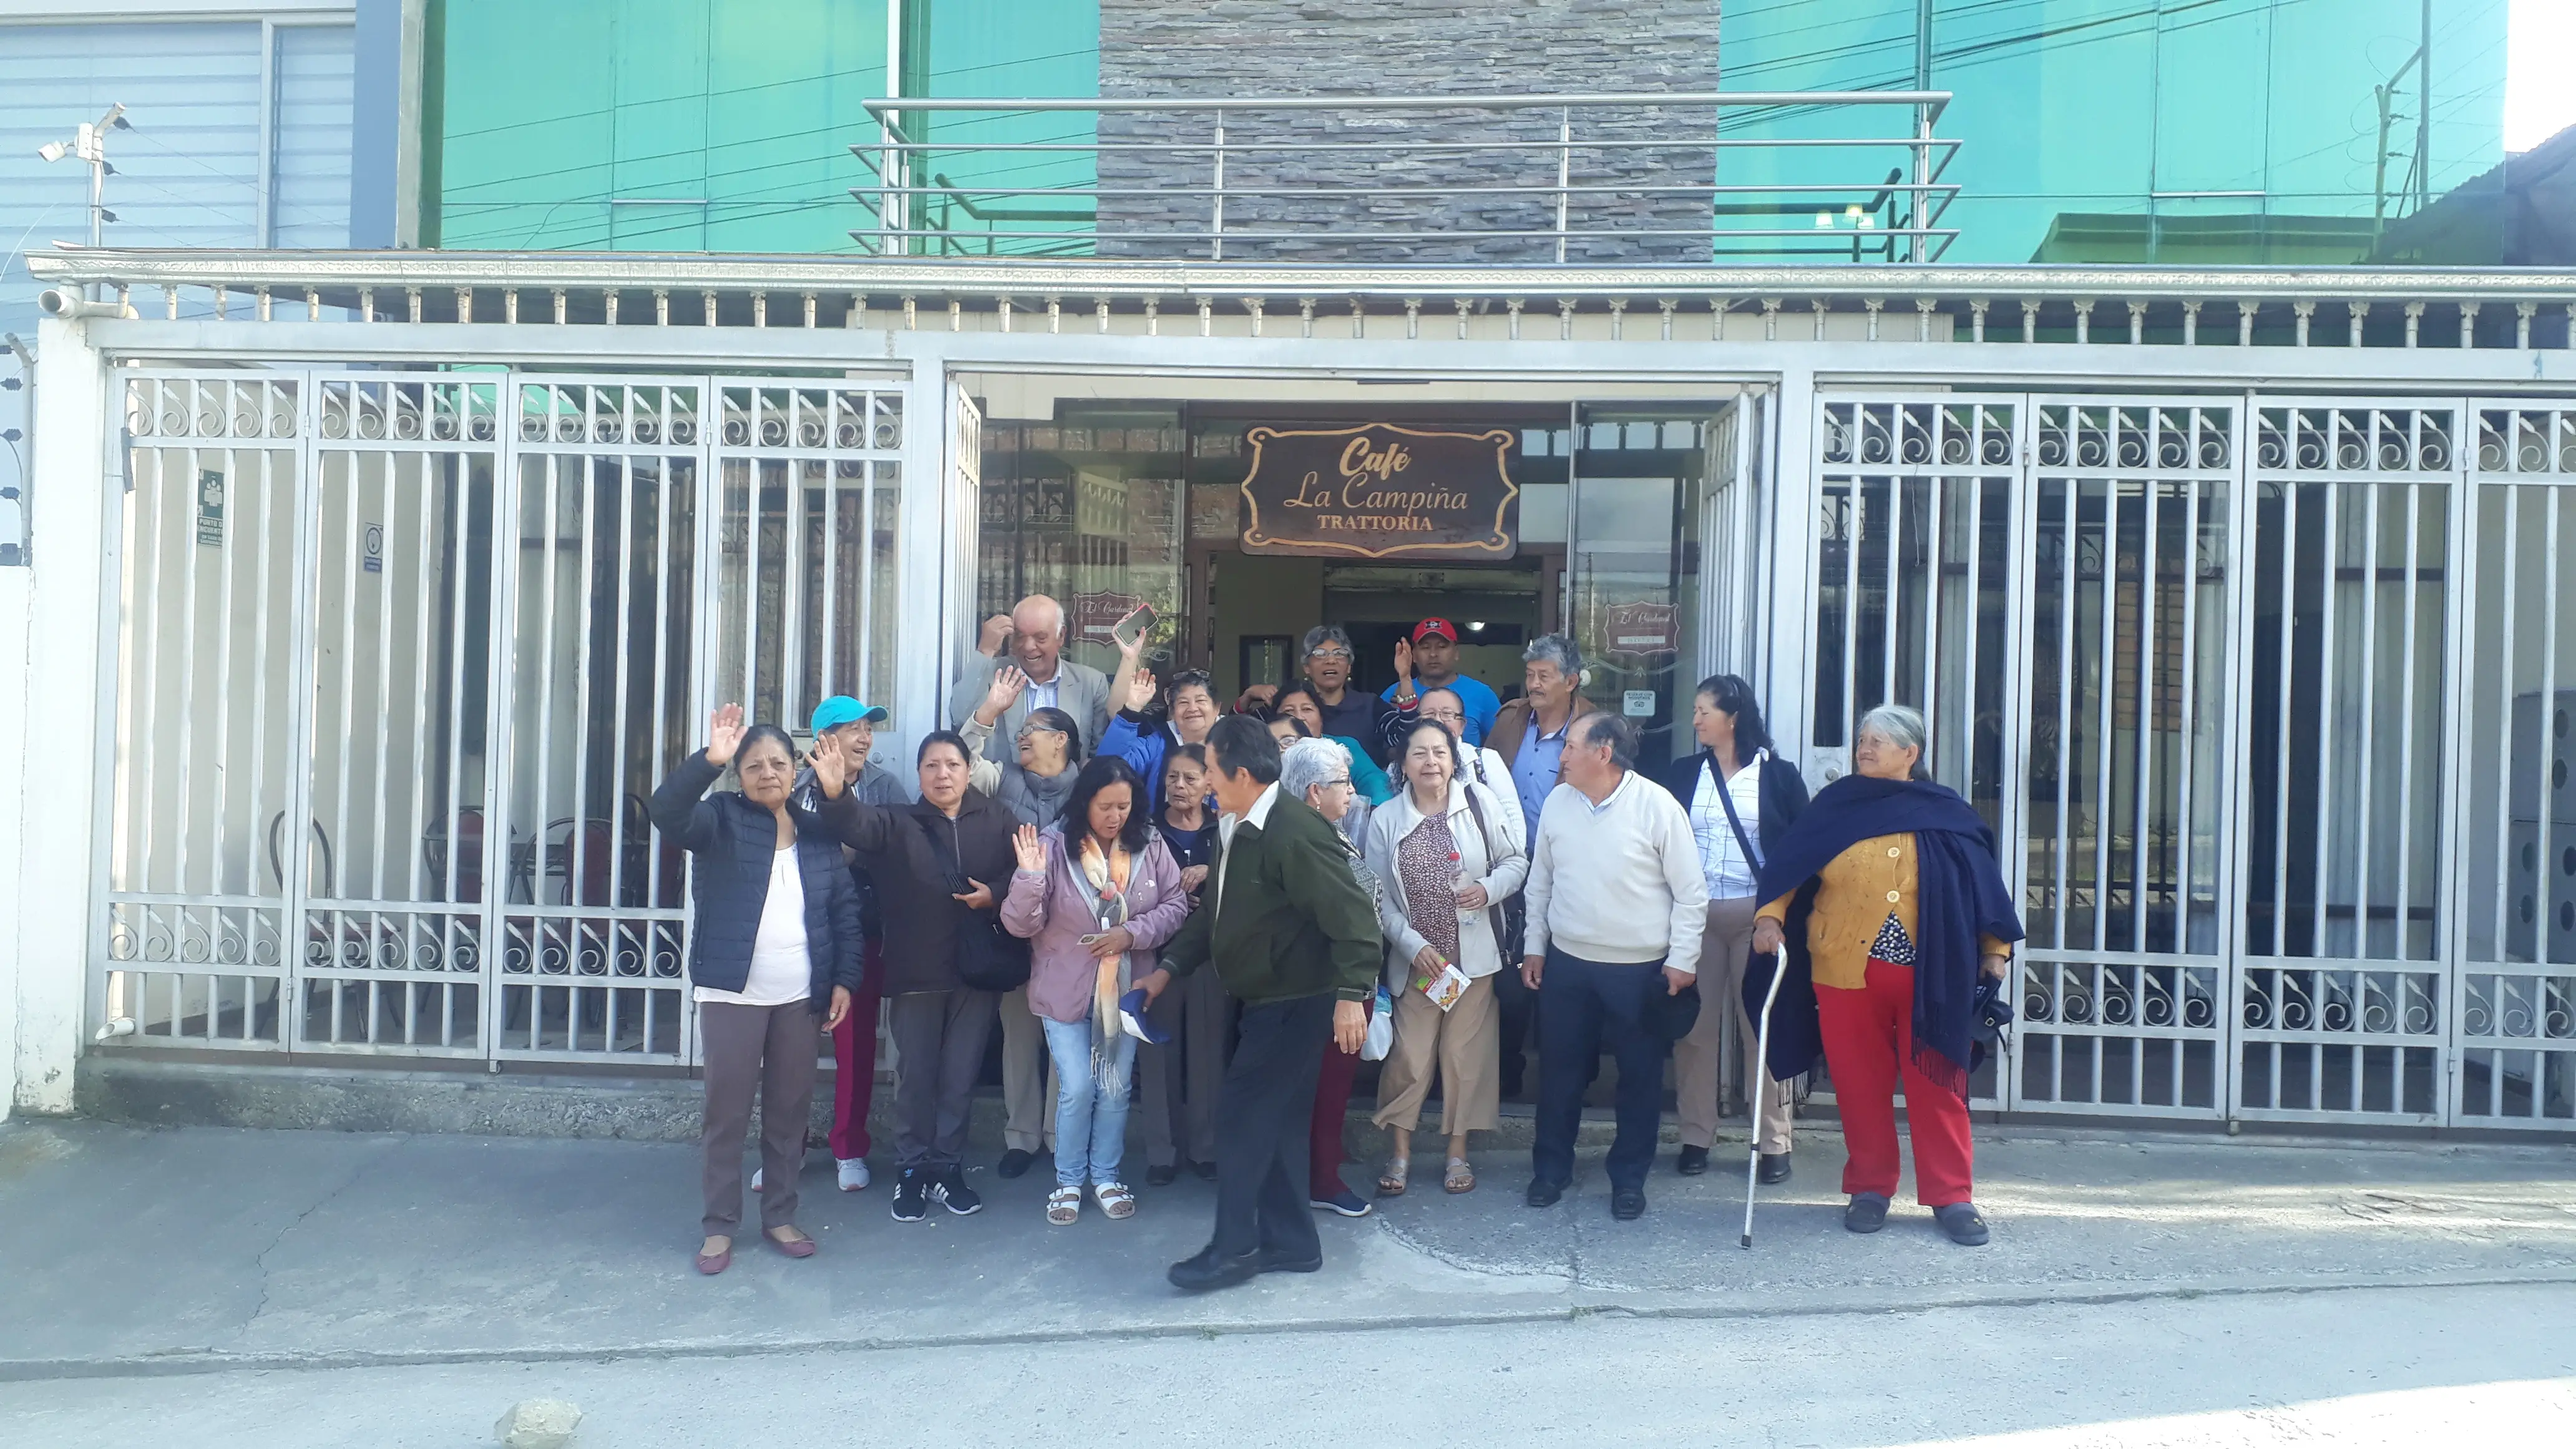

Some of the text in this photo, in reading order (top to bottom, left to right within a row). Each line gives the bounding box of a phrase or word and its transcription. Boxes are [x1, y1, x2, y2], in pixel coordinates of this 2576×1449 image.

[1339, 436, 1412, 480] Café
[1284, 471, 1468, 517] La Campiña
[1317, 514, 1434, 532] TRATTORIA
